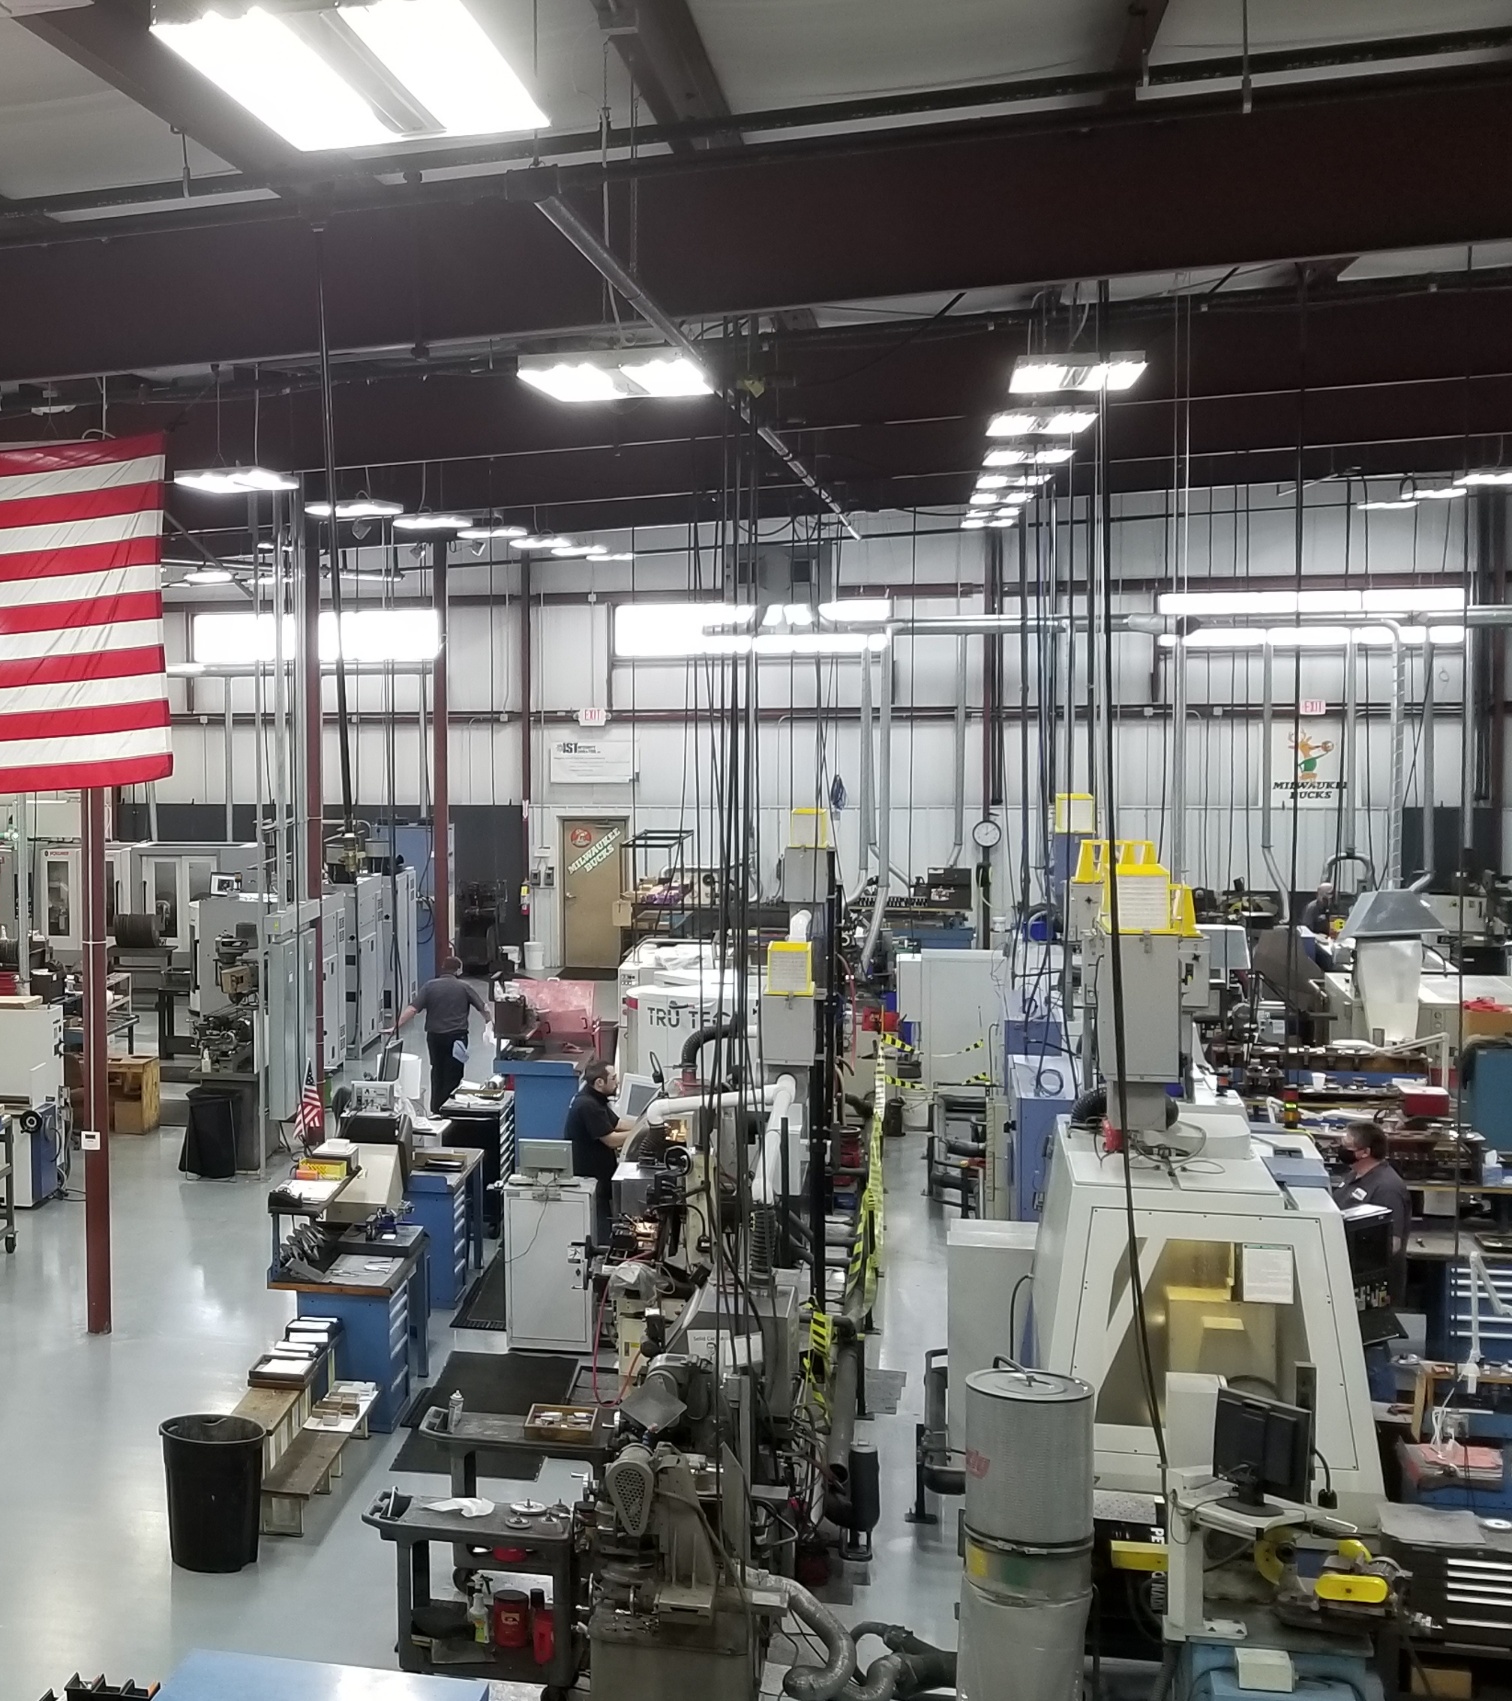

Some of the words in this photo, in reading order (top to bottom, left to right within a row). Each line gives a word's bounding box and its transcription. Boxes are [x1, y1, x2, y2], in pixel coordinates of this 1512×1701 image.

[584, 709, 601, 721] EXIT
[1304, 701, 1322, 713] EXIT
[567, 827, 621, 875] MILWAUKEE
[583, 843, 615, 873] BUCKS
[647, 1007, 680, 1028] TRU
